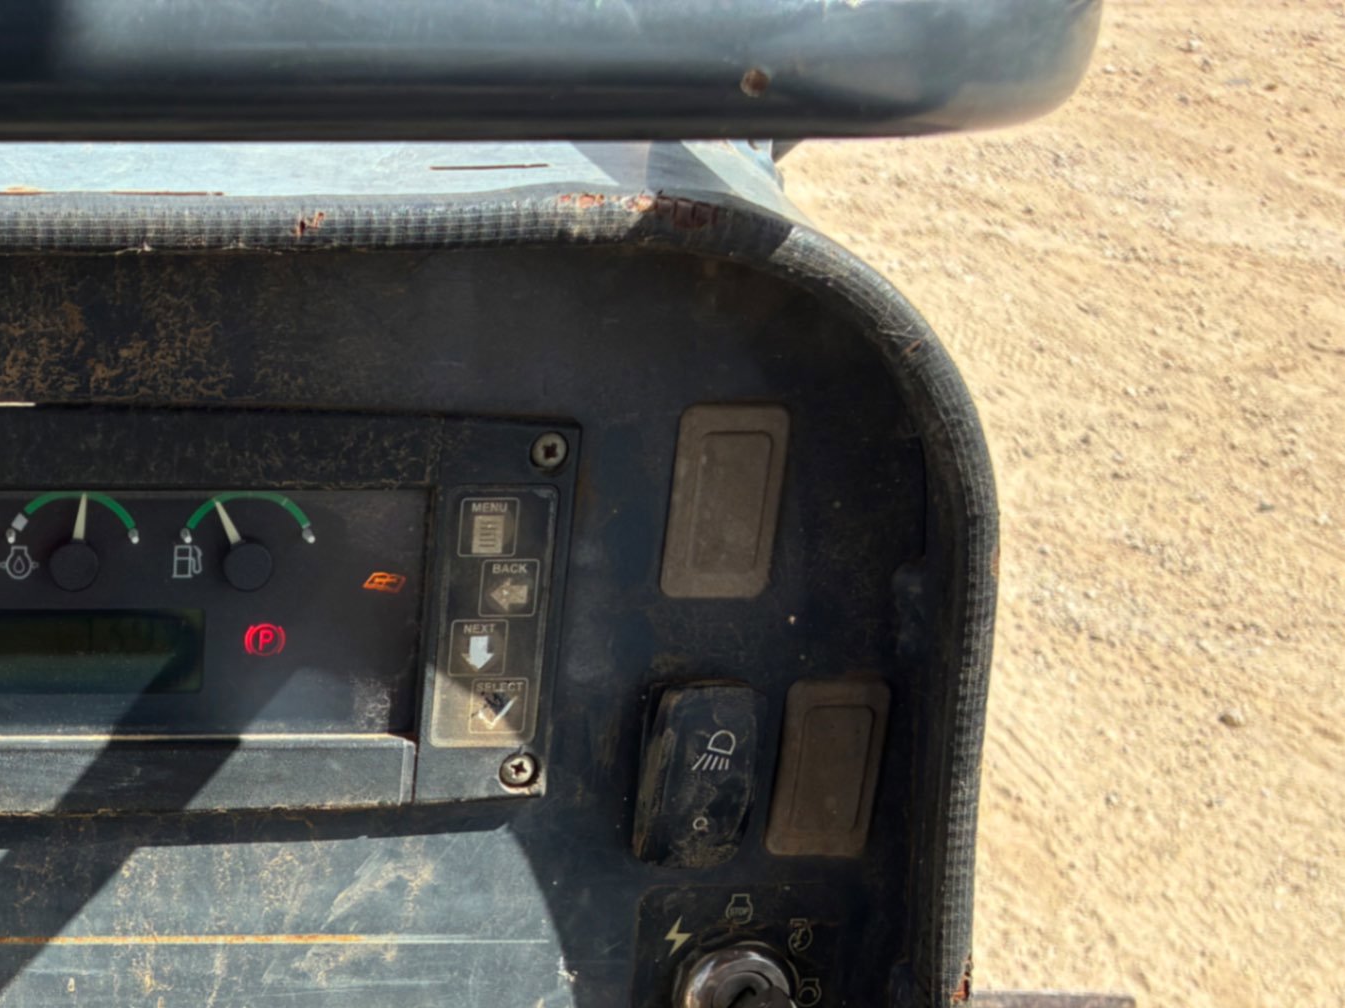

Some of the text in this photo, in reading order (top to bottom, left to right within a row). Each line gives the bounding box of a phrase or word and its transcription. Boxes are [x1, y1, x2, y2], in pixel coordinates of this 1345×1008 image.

[472, 503, 508, 513] MENU
[492, 564, 527, 574] BACK
[464, 624, 496, 634] NEXT
[258, 629, 275, 652] P
[477, 683, 523, 692] SELECT
